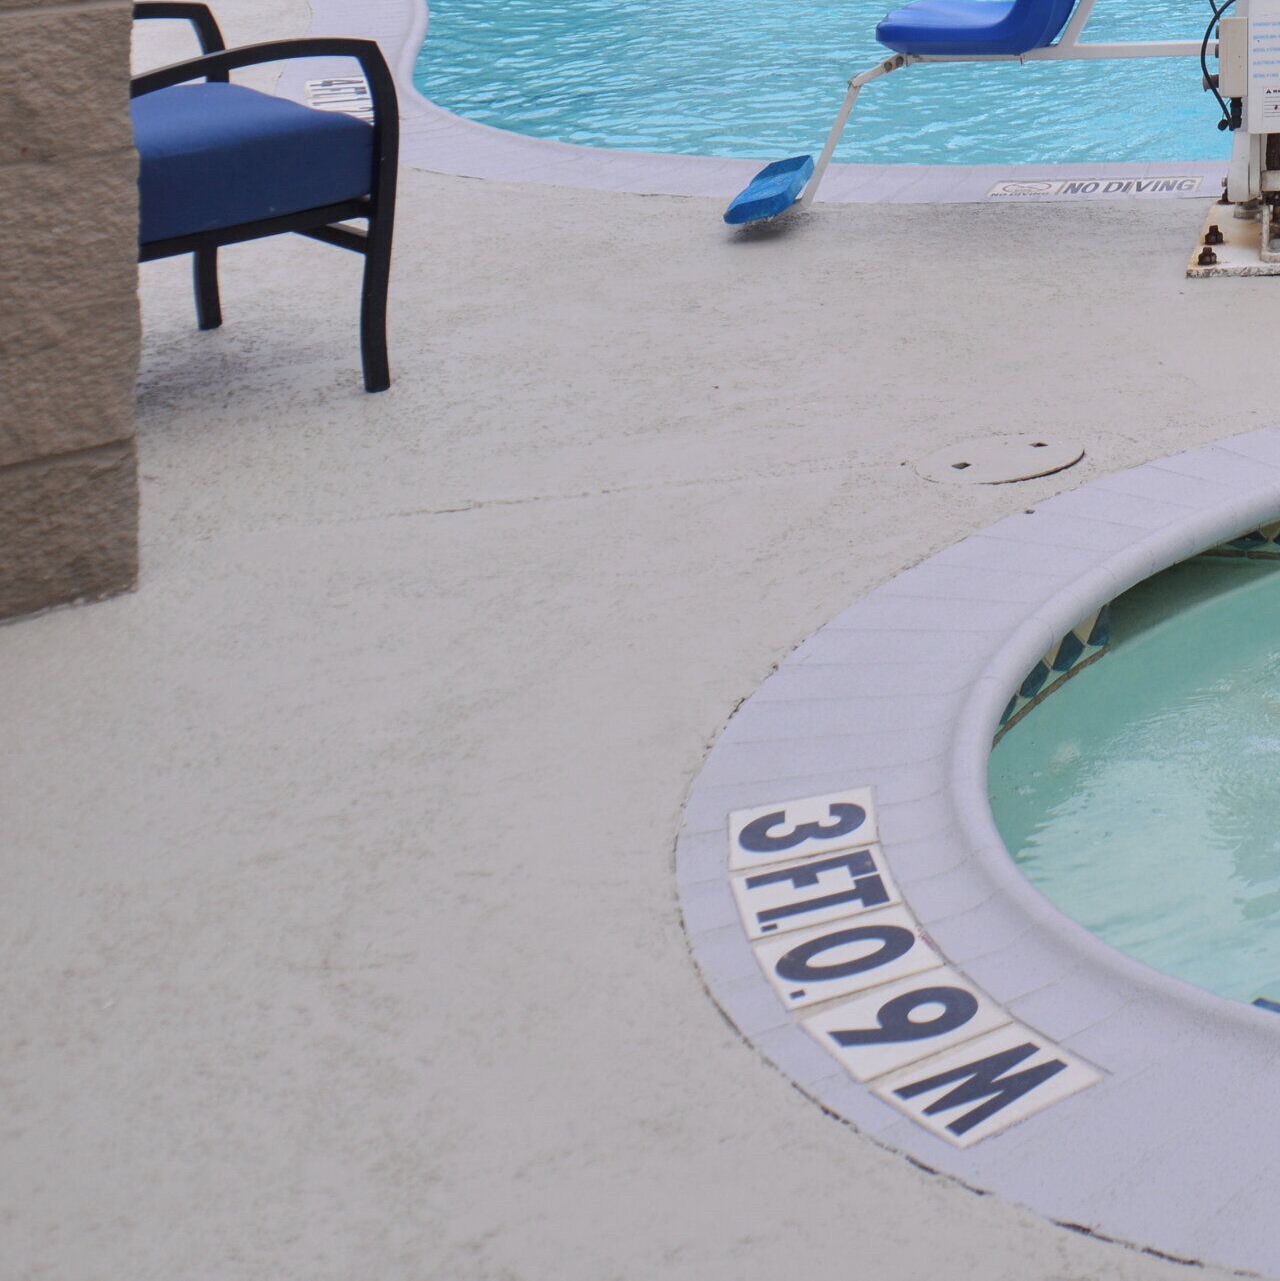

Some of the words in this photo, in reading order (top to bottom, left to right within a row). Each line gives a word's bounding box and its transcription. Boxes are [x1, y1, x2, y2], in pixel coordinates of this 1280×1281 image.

[1063, 180, 1101, 194] NO
[1102, 179, 1198, 194] DIVING
[738, 802, 867, 853] 3
[893, 1042, 1068, 1138] M
